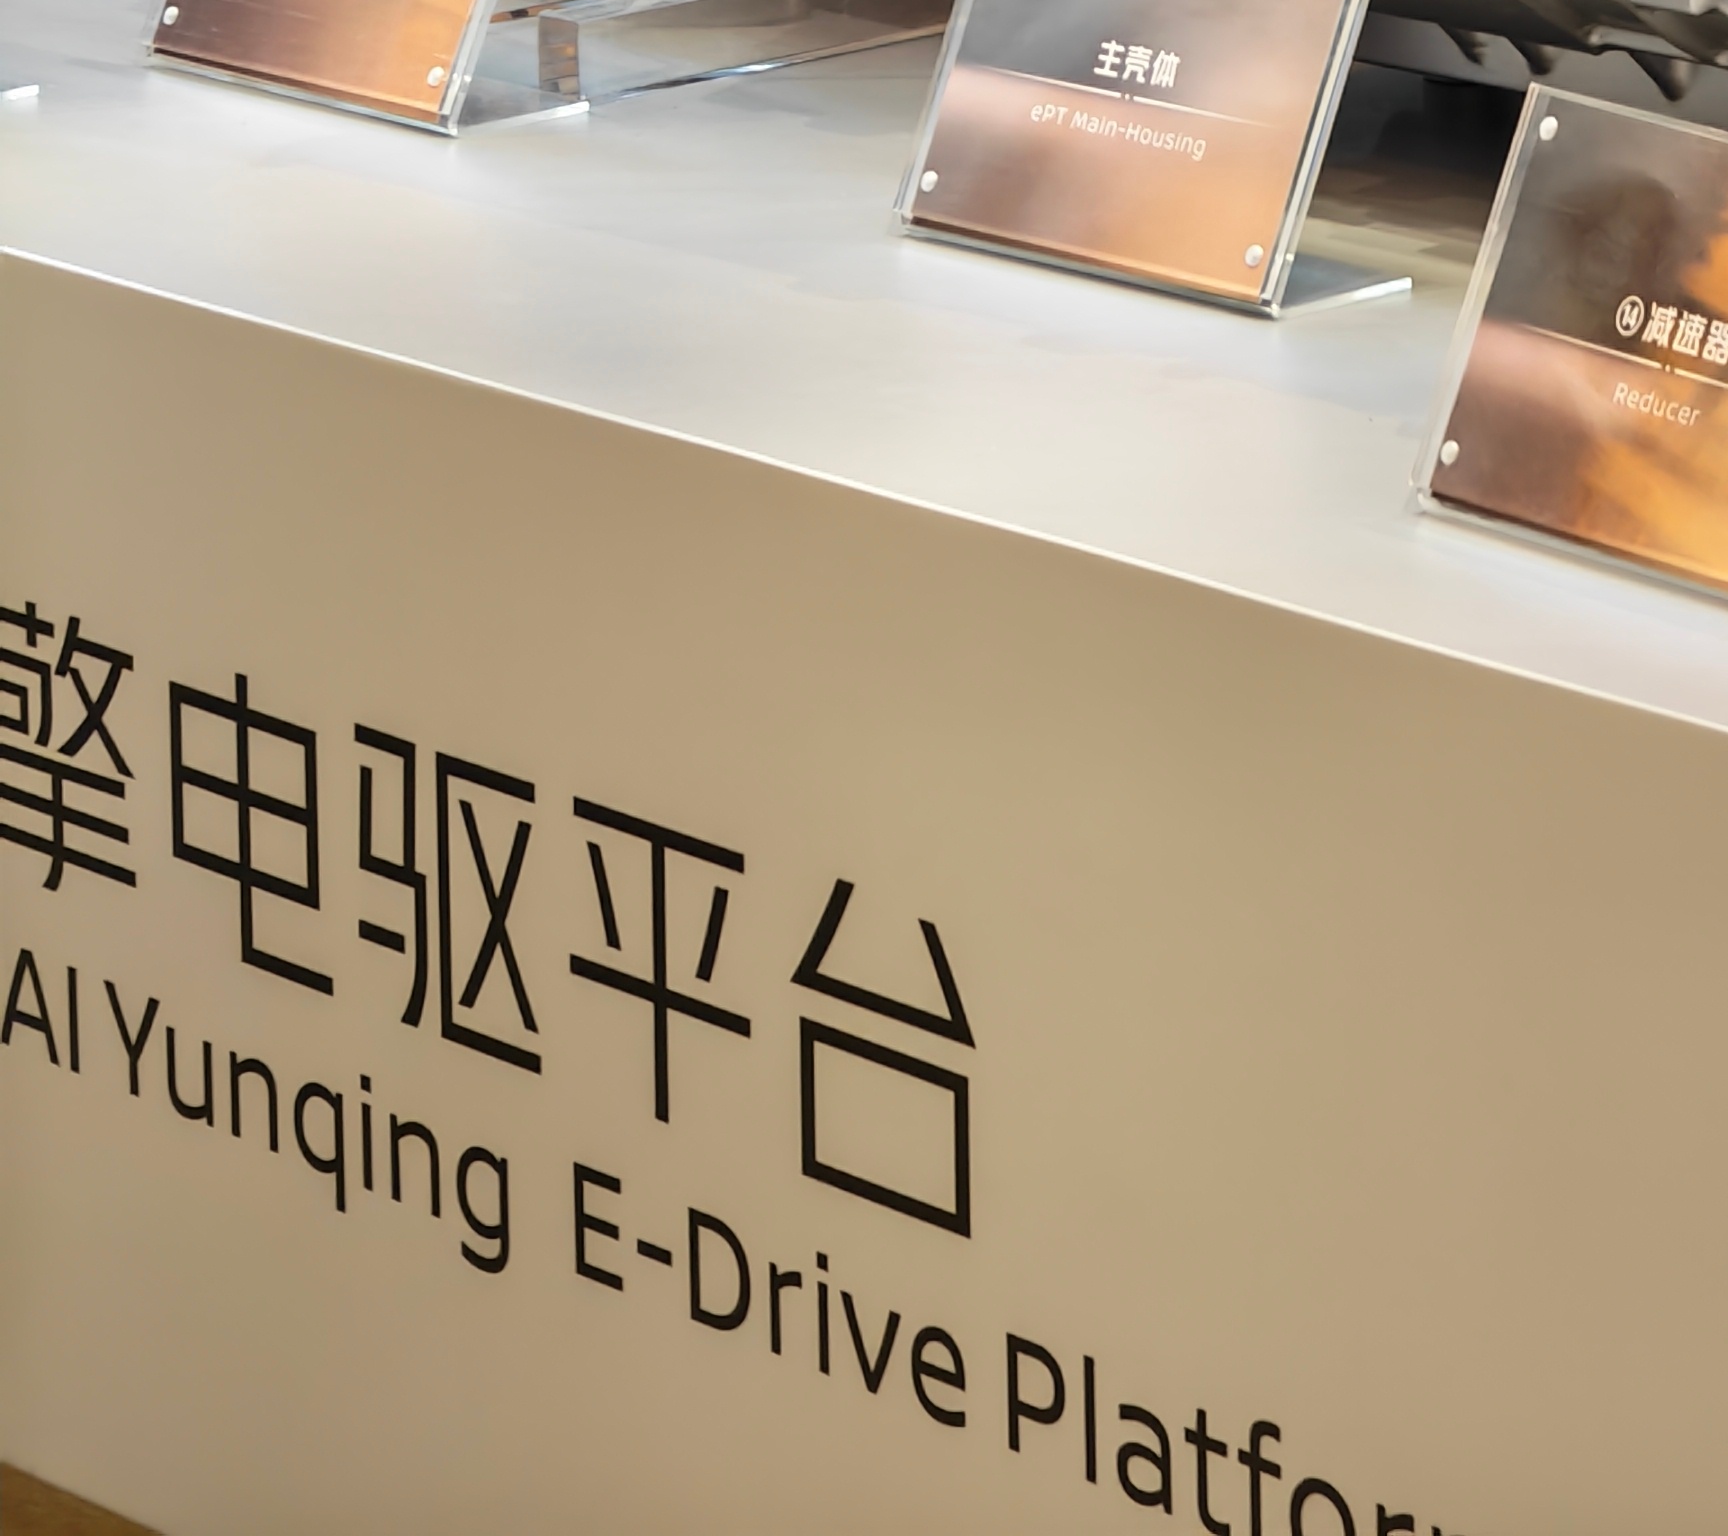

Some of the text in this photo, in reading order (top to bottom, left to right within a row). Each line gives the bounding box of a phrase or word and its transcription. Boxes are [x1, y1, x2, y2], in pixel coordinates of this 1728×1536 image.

[1093, 39, 1182, 89] 主壳体
[1030, 102, 1208, 162] ePT Main-Housing
[1612, 382, 1701, 429] Reducer
[1, 947, 1474, 1536] AI Yunqing E-Drive Platfo
